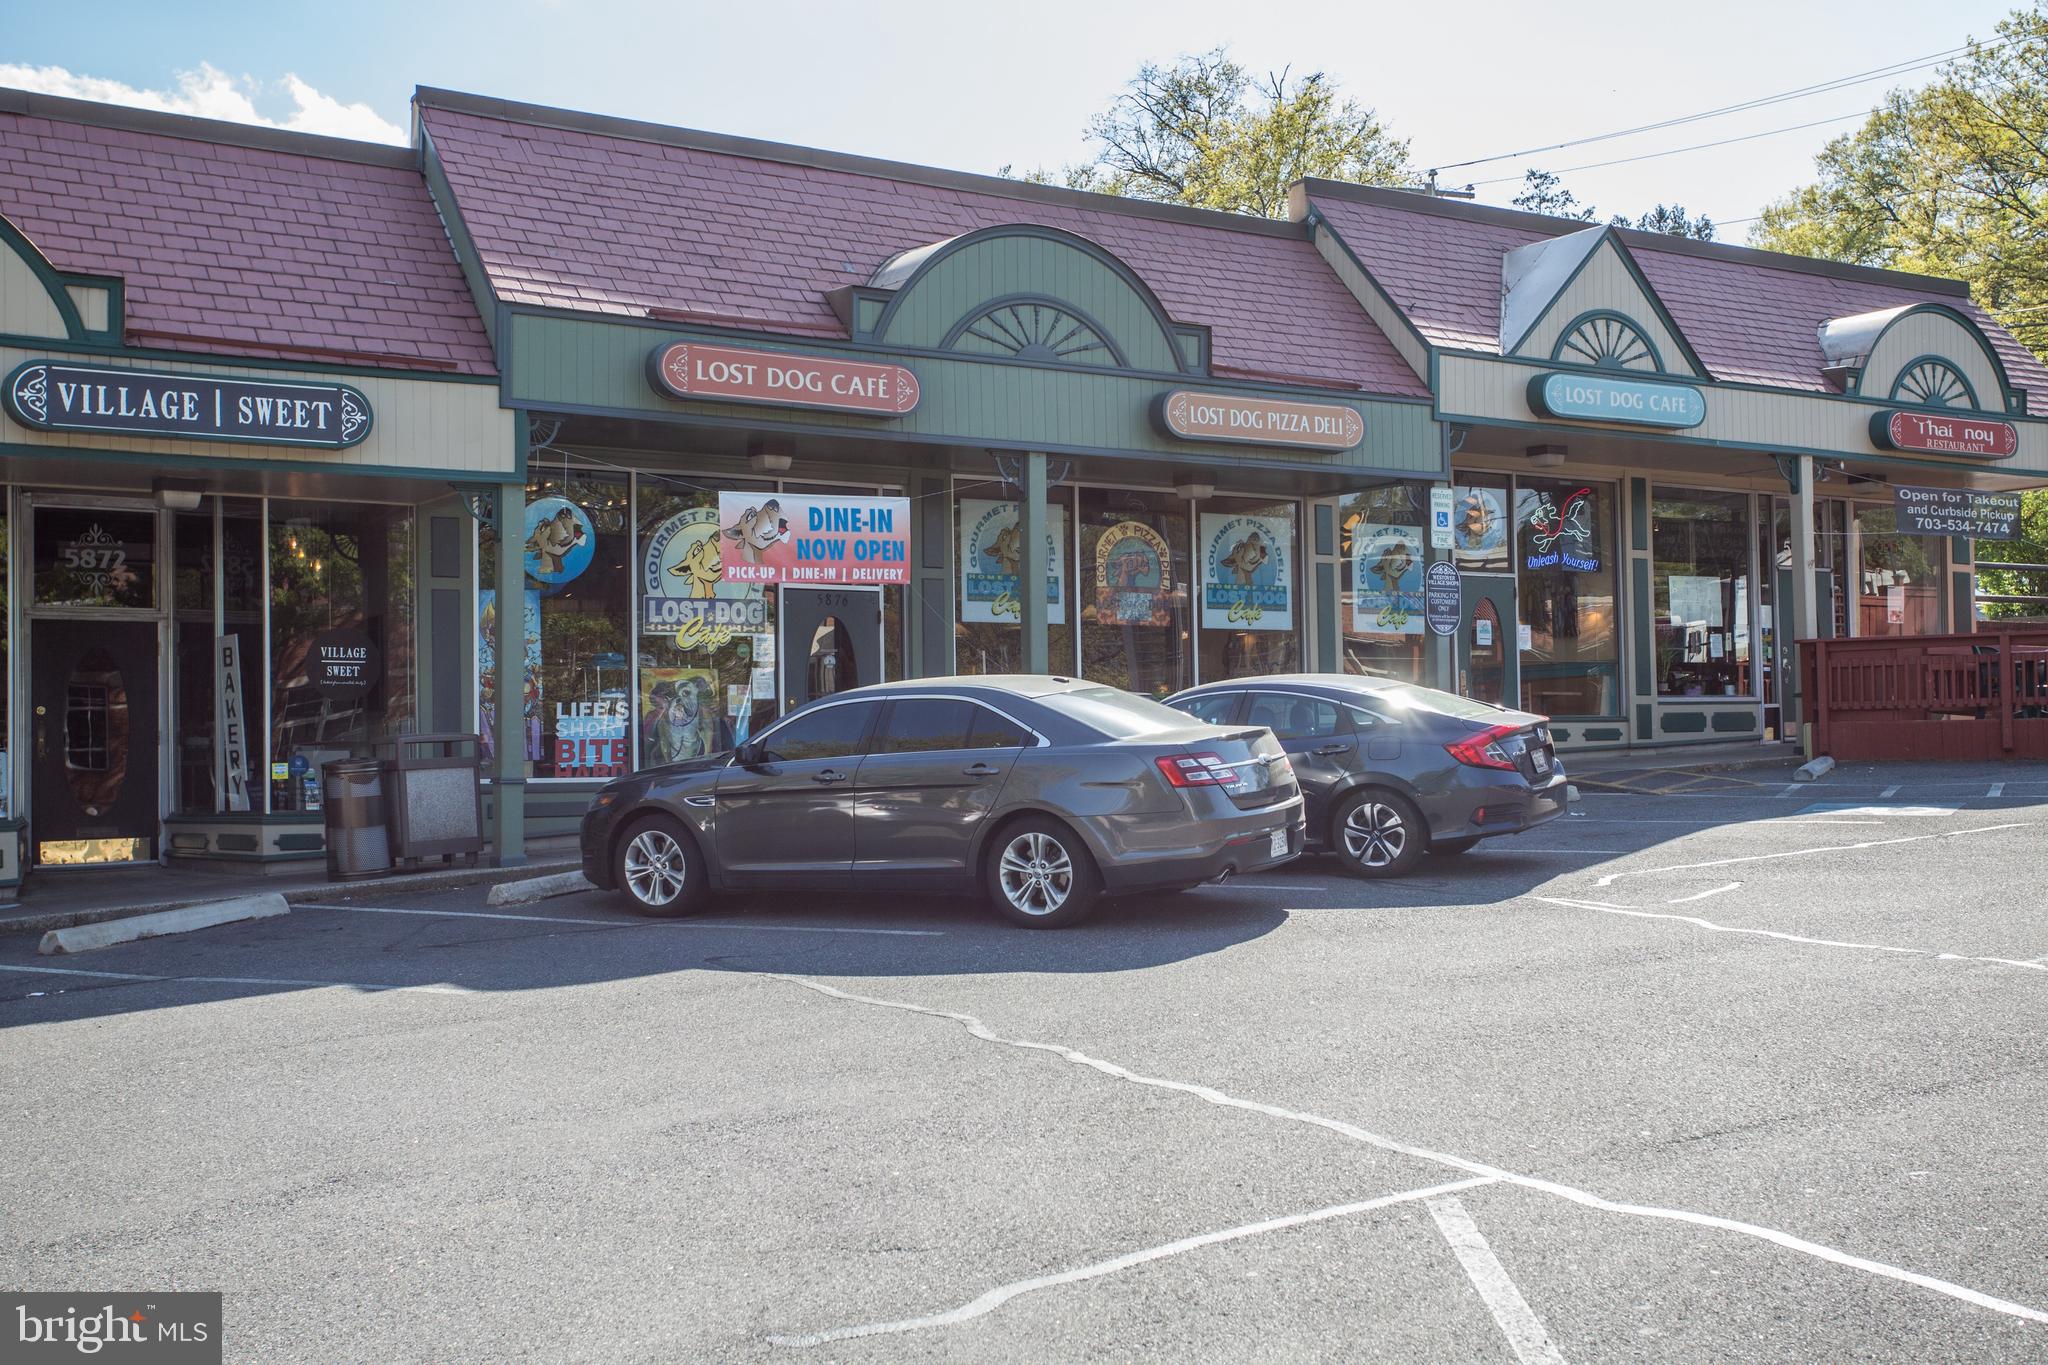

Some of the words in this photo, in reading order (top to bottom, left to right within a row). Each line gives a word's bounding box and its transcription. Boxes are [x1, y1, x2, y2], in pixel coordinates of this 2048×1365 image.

[696, 360, 758, 386] LOST
[767, 367, 823, 393] DOG
[831, 373, 890, 399] CAFÉ
[57, 382, 200, 422] VILLAGE
[238, 396, 333, 430] SWEET
[1566, 386, 1603, 406] LOST
[1610, 391, 1644, 410] DOG
[1650, 395, 1687, 414] CAFE
[1190, 405, 1225, 426] LOST
[1230, 409, 1263, 429] DOG
[1268, 413, 1310, 433] PIZZA
[1314, 417, 1343, 436] DELI
[1912, 416, 1953, 438] Thai
[1964, 428, 1994, 447] noy
[1926, 438, 1985, 453] RESTAURANT
[1899, 489, 1938, 502] Open
[1942, 491, 1962, 503] for
[1965, 493, 2019, 507] Takeout
[808, 506, 893, 533] DINE-IN
[1907, 505, 1928, 515] and
[1930, 505, 1978, 518] Curbside
[1980, 508, 2015, 522] Pickup
[1915, 517, 2010, 534] 703-534-7474
[969, 504, 1009, 569] GOURMET
[64, 548, 127, 569] 5872
[649, 511, 698, 591] GOURMET
[796, 538, 846, 561] NOW
[853, 539, 905, 562] OPEN
[1097, 532, 1118, 583] GOURMET
[1133, 525, 1160, 551] PIZZA
[1161, 560, 1170, 591] DELI
[1207, 518, 1242, 578] GOURMET
[1246, 518, 1277, 547] PIZZA
[1274, 546, 1285, 583] DELI
[1527, 551, 1559, 568] Unleash
[1561, 552, 1599, 572] Yourself!
[728, 566, 776, 580] PICK-UP
[792, 567, 837, 580] DINE-IN
[852, 568, 904, 581] DELIVERY
[968, 580, 1015, 594] LOST
[1207, 588, 1248, 603] LOST
[1252, 591, 1287, 605] DOG
[648, 600, 709, 624] LOST
[715, 601, 764, 625] DOG
[320, 646, 367, 658] VILLAGE
[326, 665, 361, 677] SWEET
[222, 646, 242, 795] BAKERY
[556, 700, 630, 720] LIFE'S
[555, 721, 630, 738] SHORT
[555, 739, 628, 763] BITE
